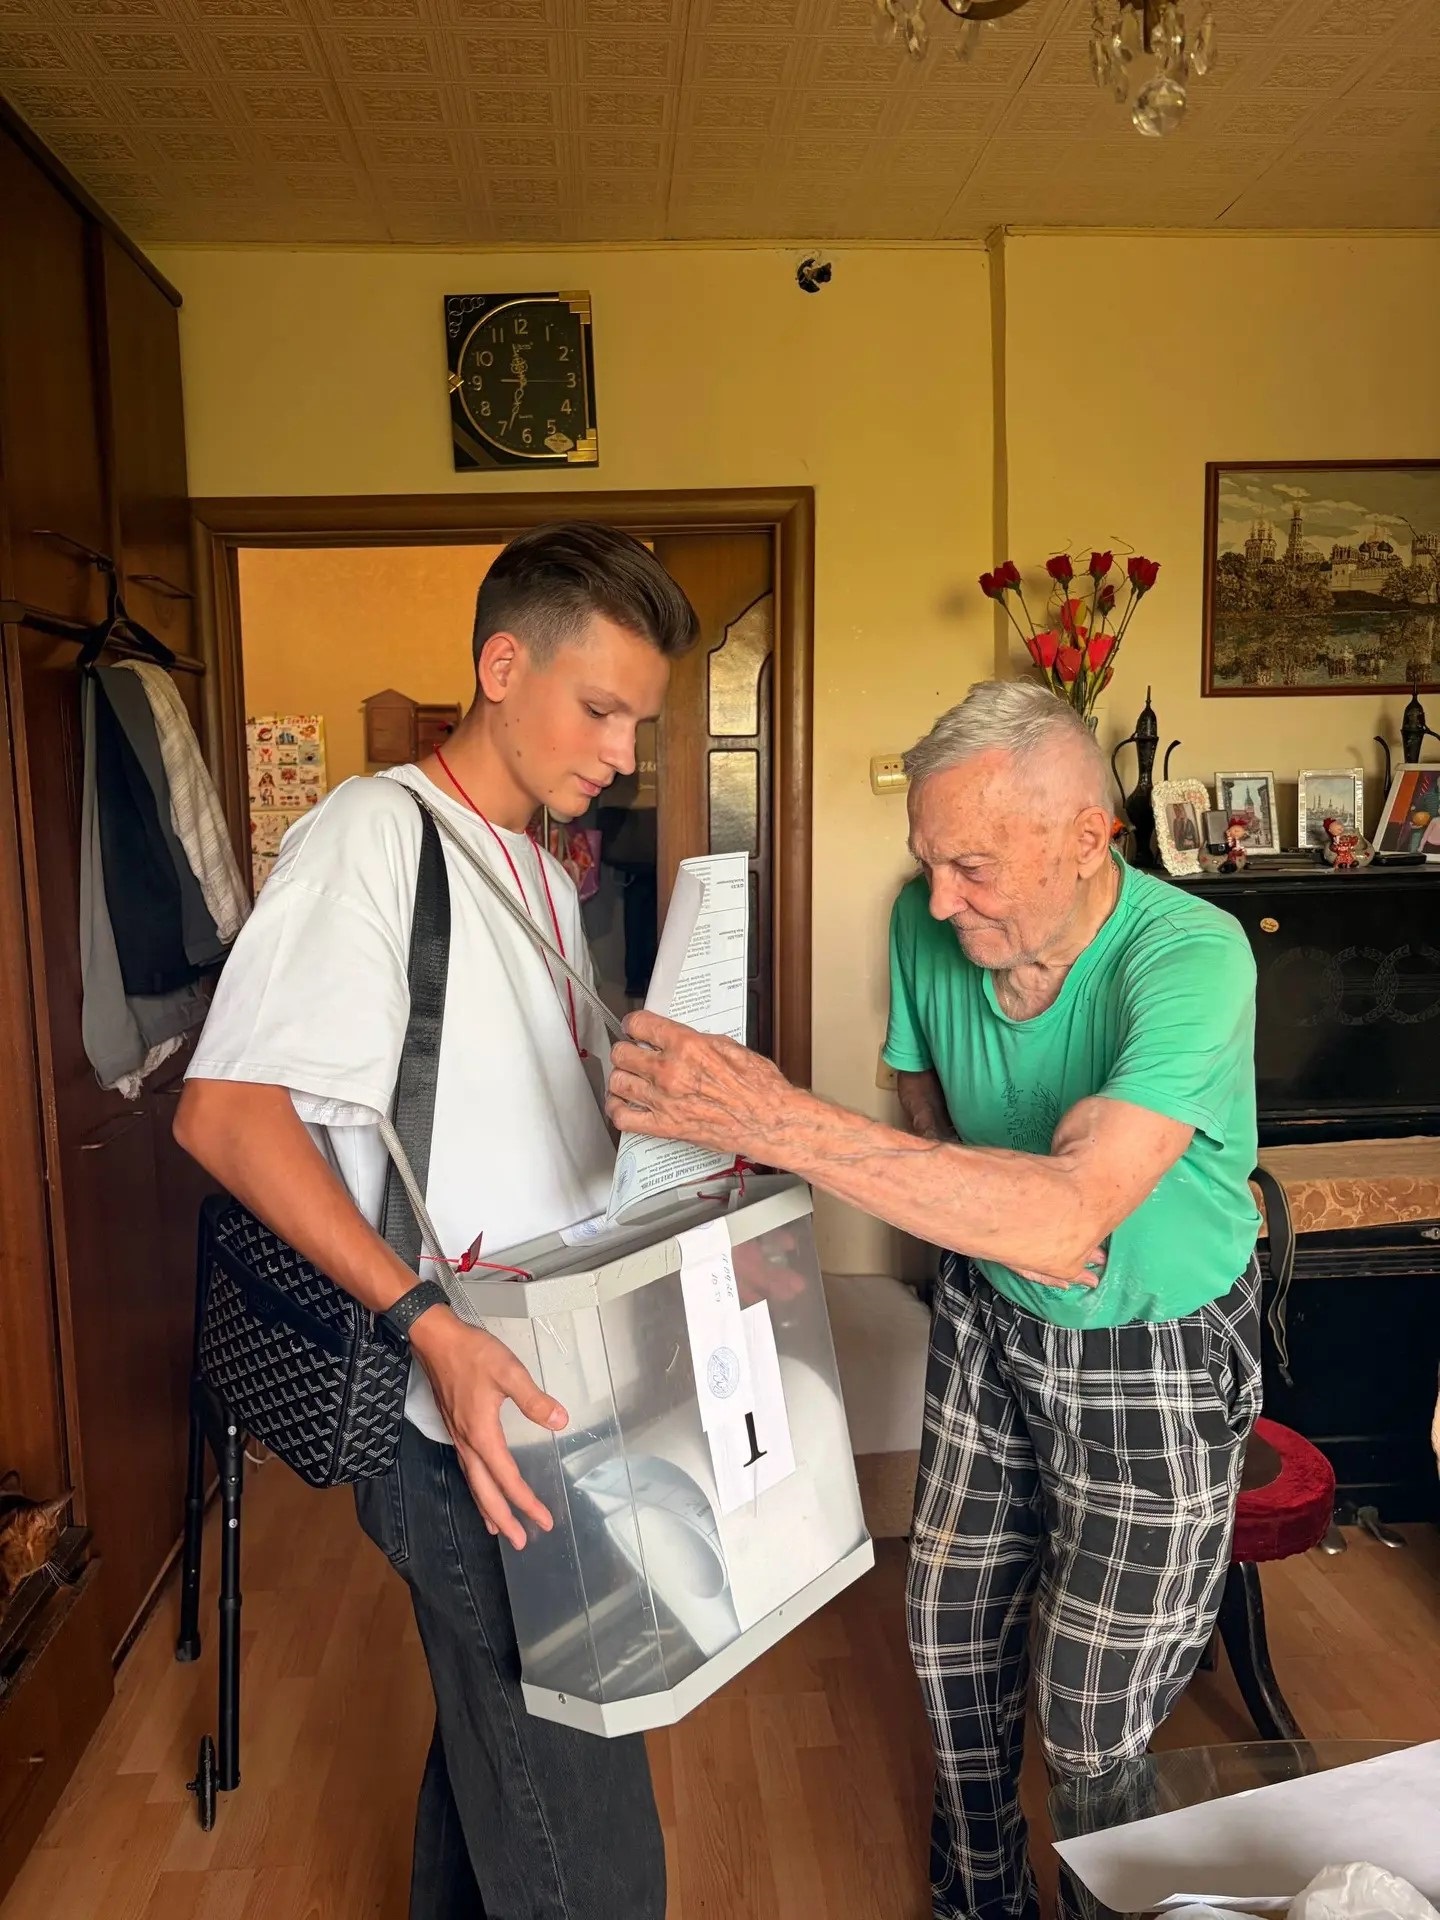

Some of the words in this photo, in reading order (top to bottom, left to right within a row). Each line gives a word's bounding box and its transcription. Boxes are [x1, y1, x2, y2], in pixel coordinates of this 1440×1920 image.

[514, 318, 529, 335] 12
[492, 327, 504, 343] 11
[476, 351, 494, 367] 10
[559, 346, 569, 361] 2
[472, 375, 482, 391] 9
[566, 372, 577, 388] 3
[480, 401, 491, 416] 8
[560, 399, 572, 415] 4
[497, 420, 508, 436] 7
[546, 419, 556, 435] 5
[521, 428, 532, 444] 6
[743, 1411, 768, 1468] 1
